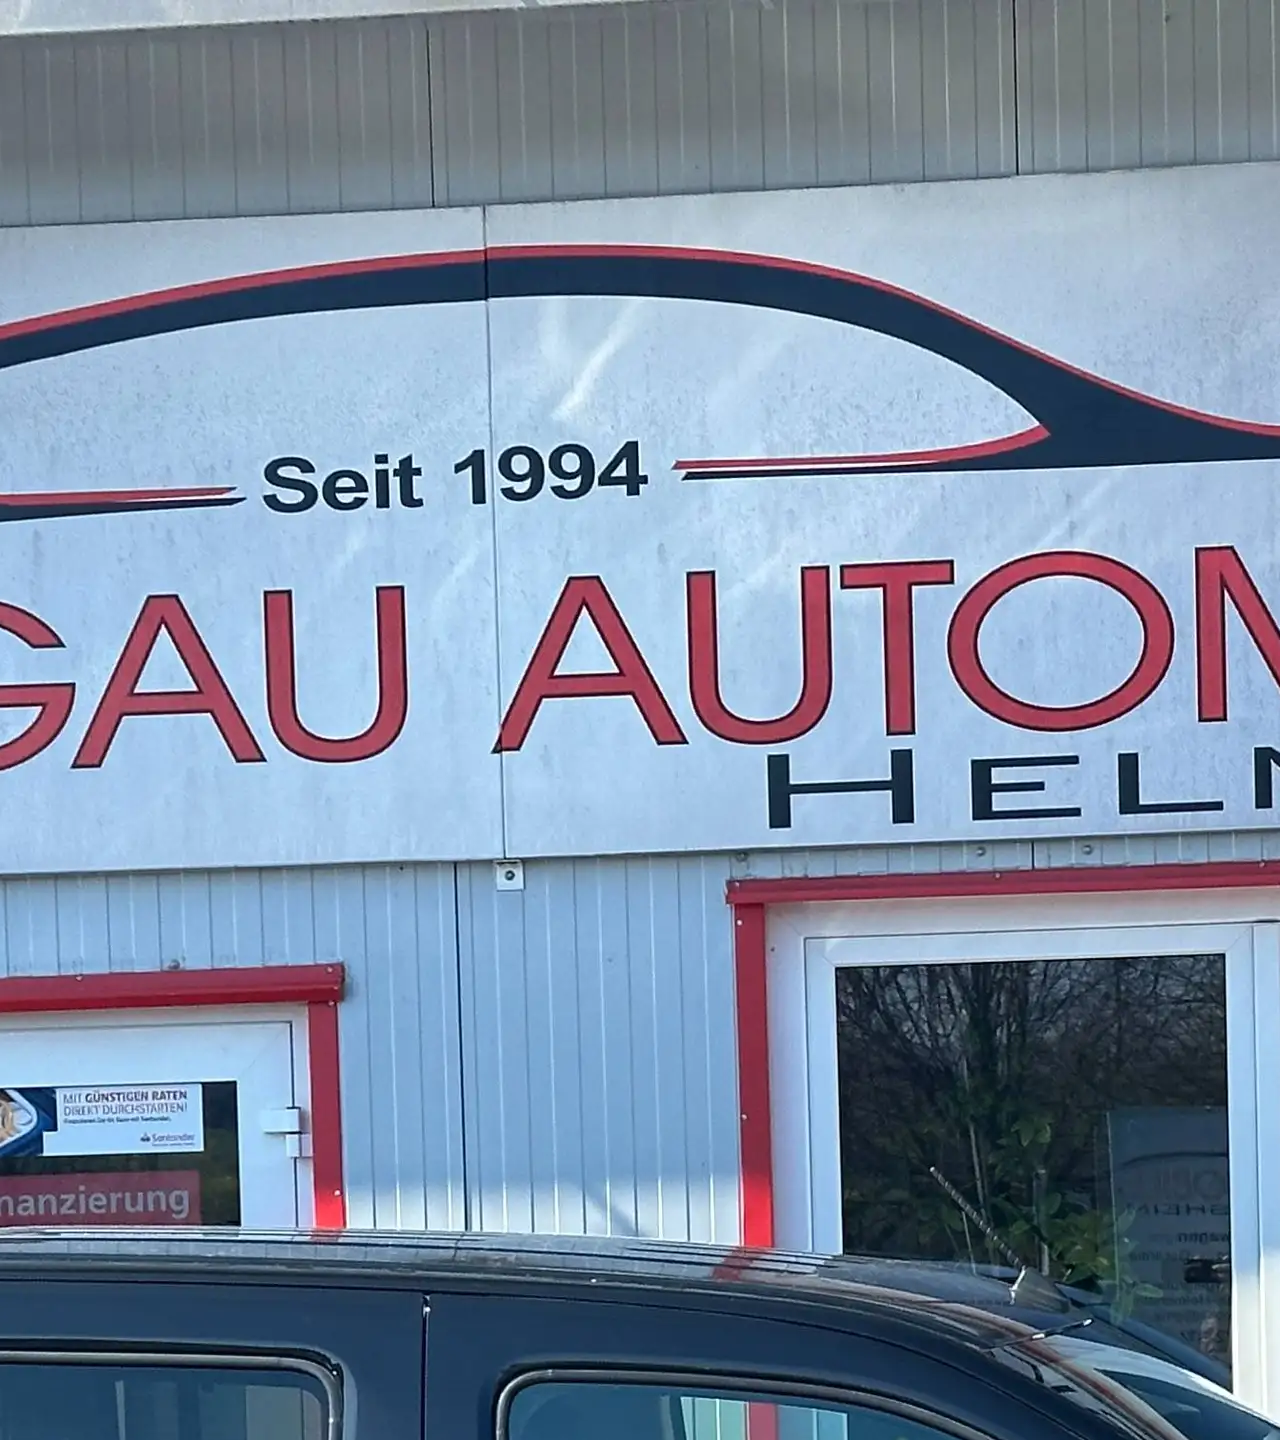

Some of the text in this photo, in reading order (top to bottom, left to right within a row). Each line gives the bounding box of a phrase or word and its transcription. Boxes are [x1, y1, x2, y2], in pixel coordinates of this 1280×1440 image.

[261, 440, 649, 514] Seit 1994
[63, 1089, 188, 1104] MIT GÜNSTIGEN RATEN
[63, 1102, 188, 1116] DIREKT DURCHSTARTEN!
[152, 1133, 195, 1142] Santander
